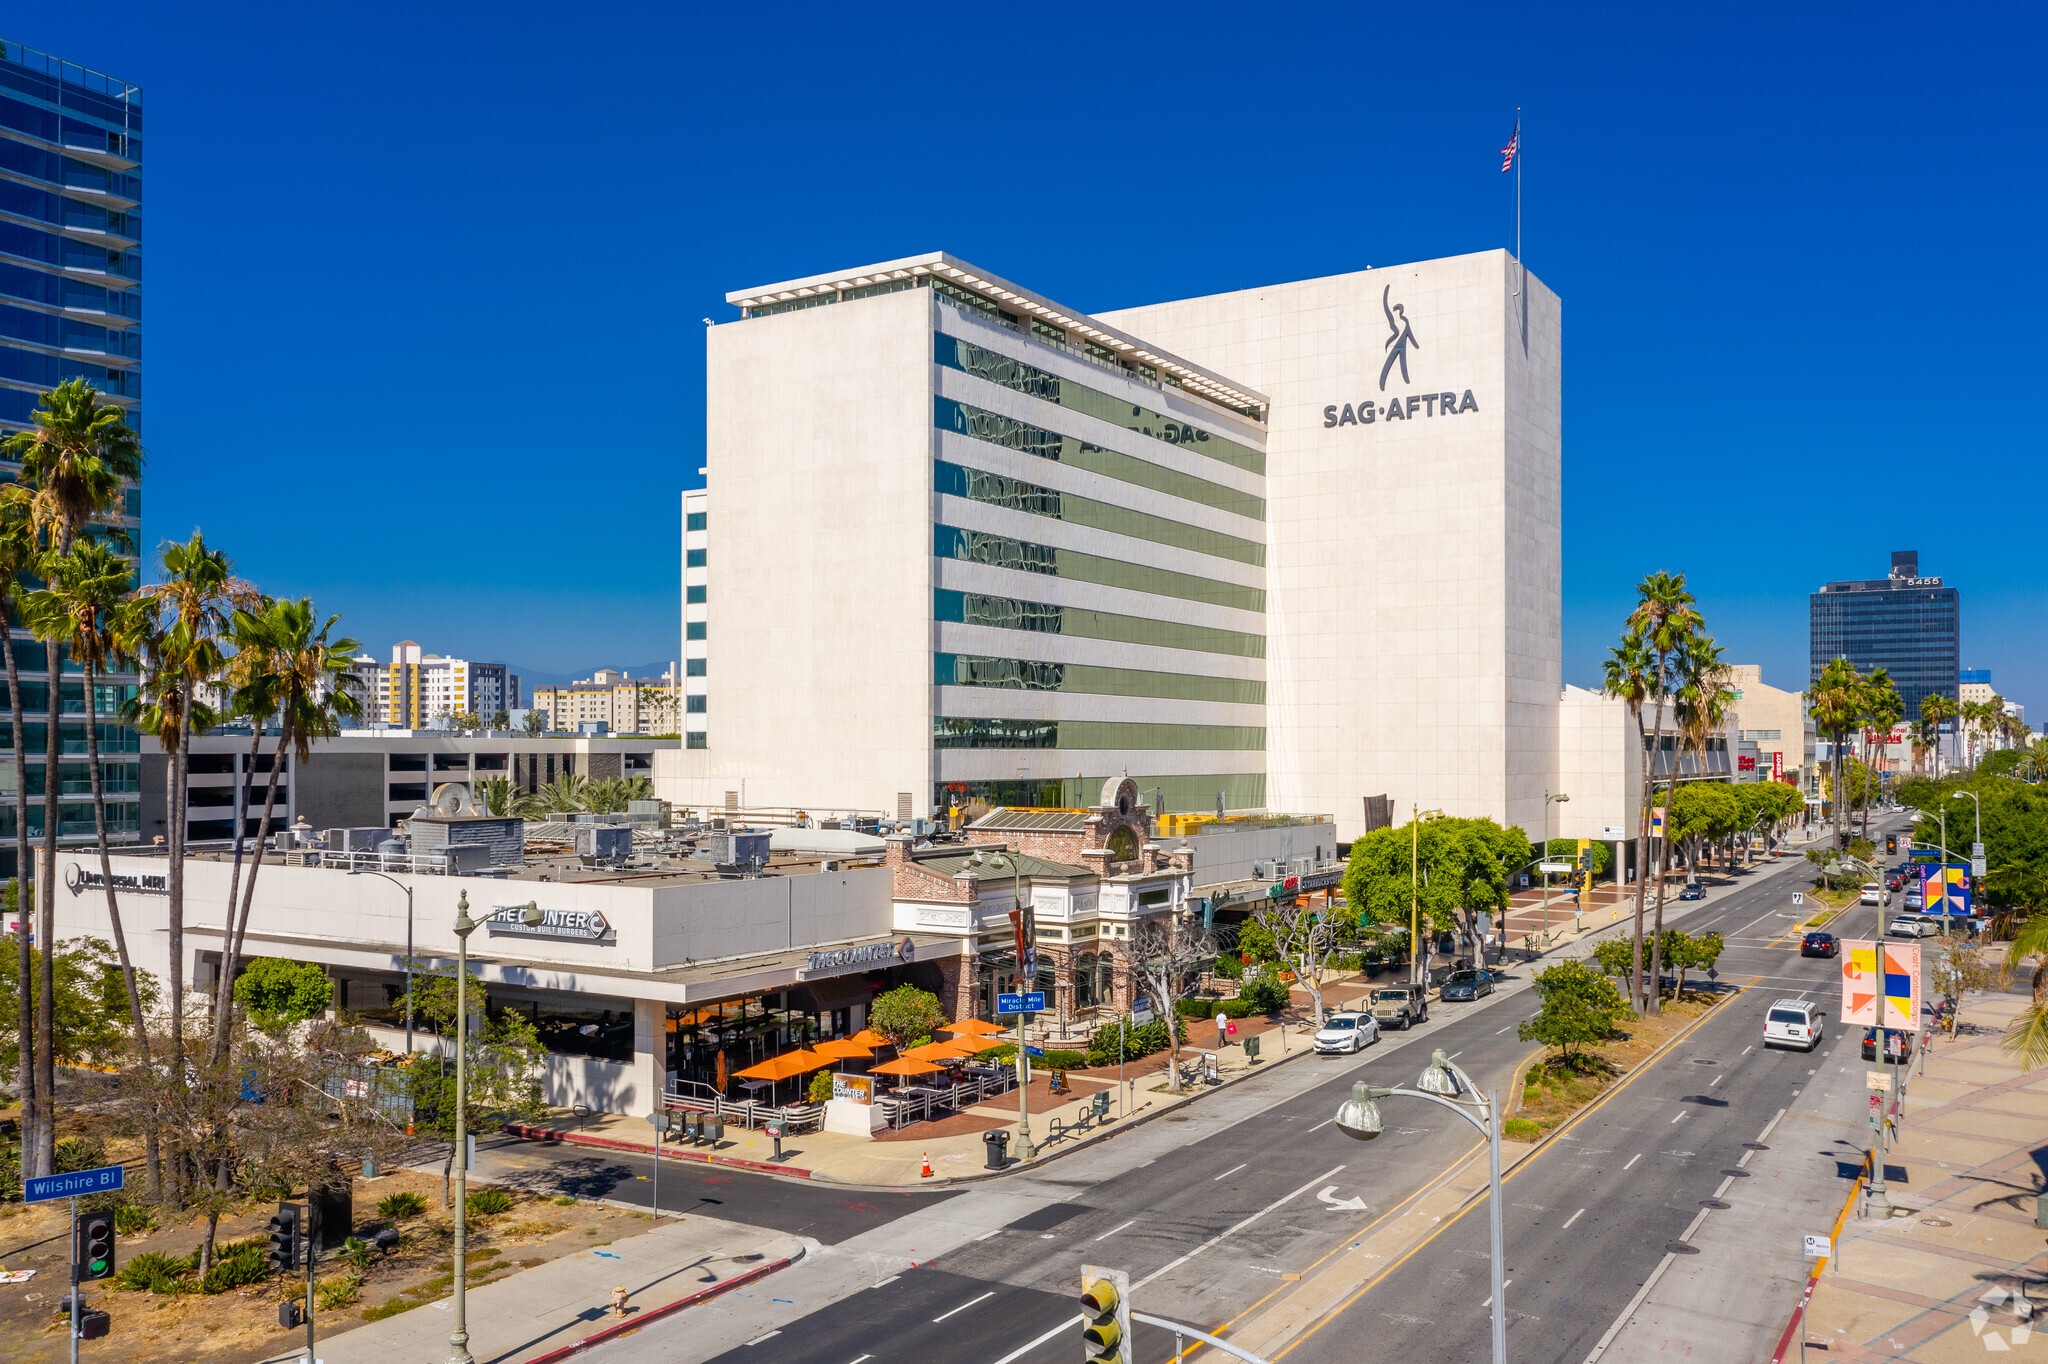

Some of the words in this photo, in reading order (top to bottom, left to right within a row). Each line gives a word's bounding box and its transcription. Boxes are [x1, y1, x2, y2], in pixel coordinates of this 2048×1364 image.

[1908, 578, 1939, 586] 5455
[142, 874, 166, 888] MRI
[510, 923, 536, 933] CUSTOM
[537, 925, 556, 935] BUILT
[557, 927, 588, 937] BURGERS
[807, 951, 834, 970] THE
[834, 941, 896, 967] COUNTER
[1912, 946, 1920, 968] Craft
[828, 964, 852, 977] CUSTOM
[1001, 997, 1026, 1005] Miracle
[1911, 969, 1920, 1027] Contemporary
[833, 1087, 865, 1096] COUNTER
[34, 1176, 94, 1195] Wilshire
[100, 1172, 115, 1185] Bl
